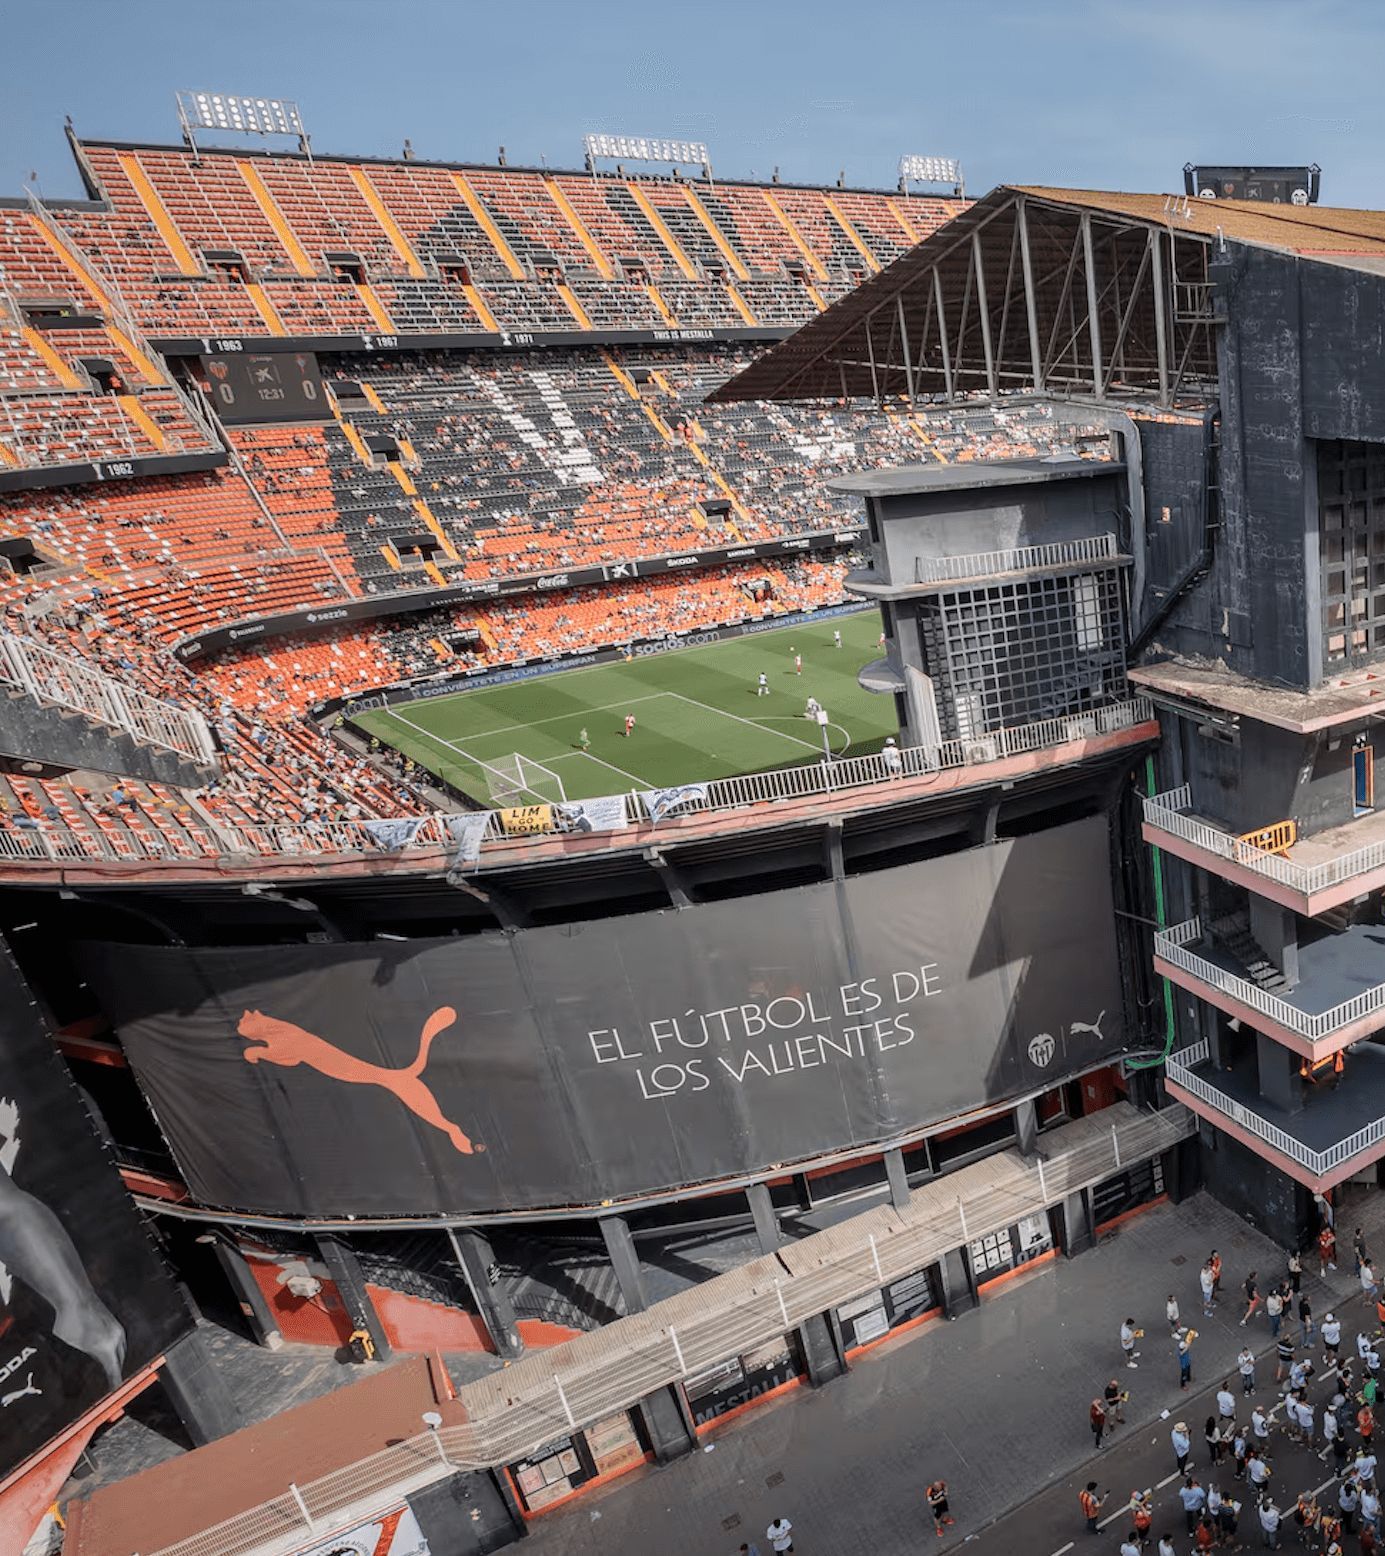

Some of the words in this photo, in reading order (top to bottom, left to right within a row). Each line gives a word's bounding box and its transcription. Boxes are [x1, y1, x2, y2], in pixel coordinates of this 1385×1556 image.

[514, 334, 534, 344] 1971
[653, 330, 670, 339] THIS
[671, 330, 679, 339] IS
[680, 329, 714, 338] MESTALLA
[216, 340, 243, 351] 1963
[376, 336, 398, 347] 1967
[218, 383, 235, 404] 0
[302, 380, 317, 400] 0
[107, 462, 134, 476] 1962
[667, 556, 698, 568] ŠKODA
[635, 630, 720, 657] socios.com
[504, 671, 519, 680] EN
[522, 667, 538, 675] UN
[541, 656, 596, 673] SUPERFAN
[512, 806, 540, 818] LIM
[507, 823, 551, 832] HOME
[588, 1028, 643, 1063] EL
[650, 992, 831, 1053] FÚTBOL
[839, 978, 882, 1016] ES
[892, 963, 943, 1004] DE
[636, 1059, 710, 1099] LOS
[717, 1013, 915, 1083] VALIENTES
